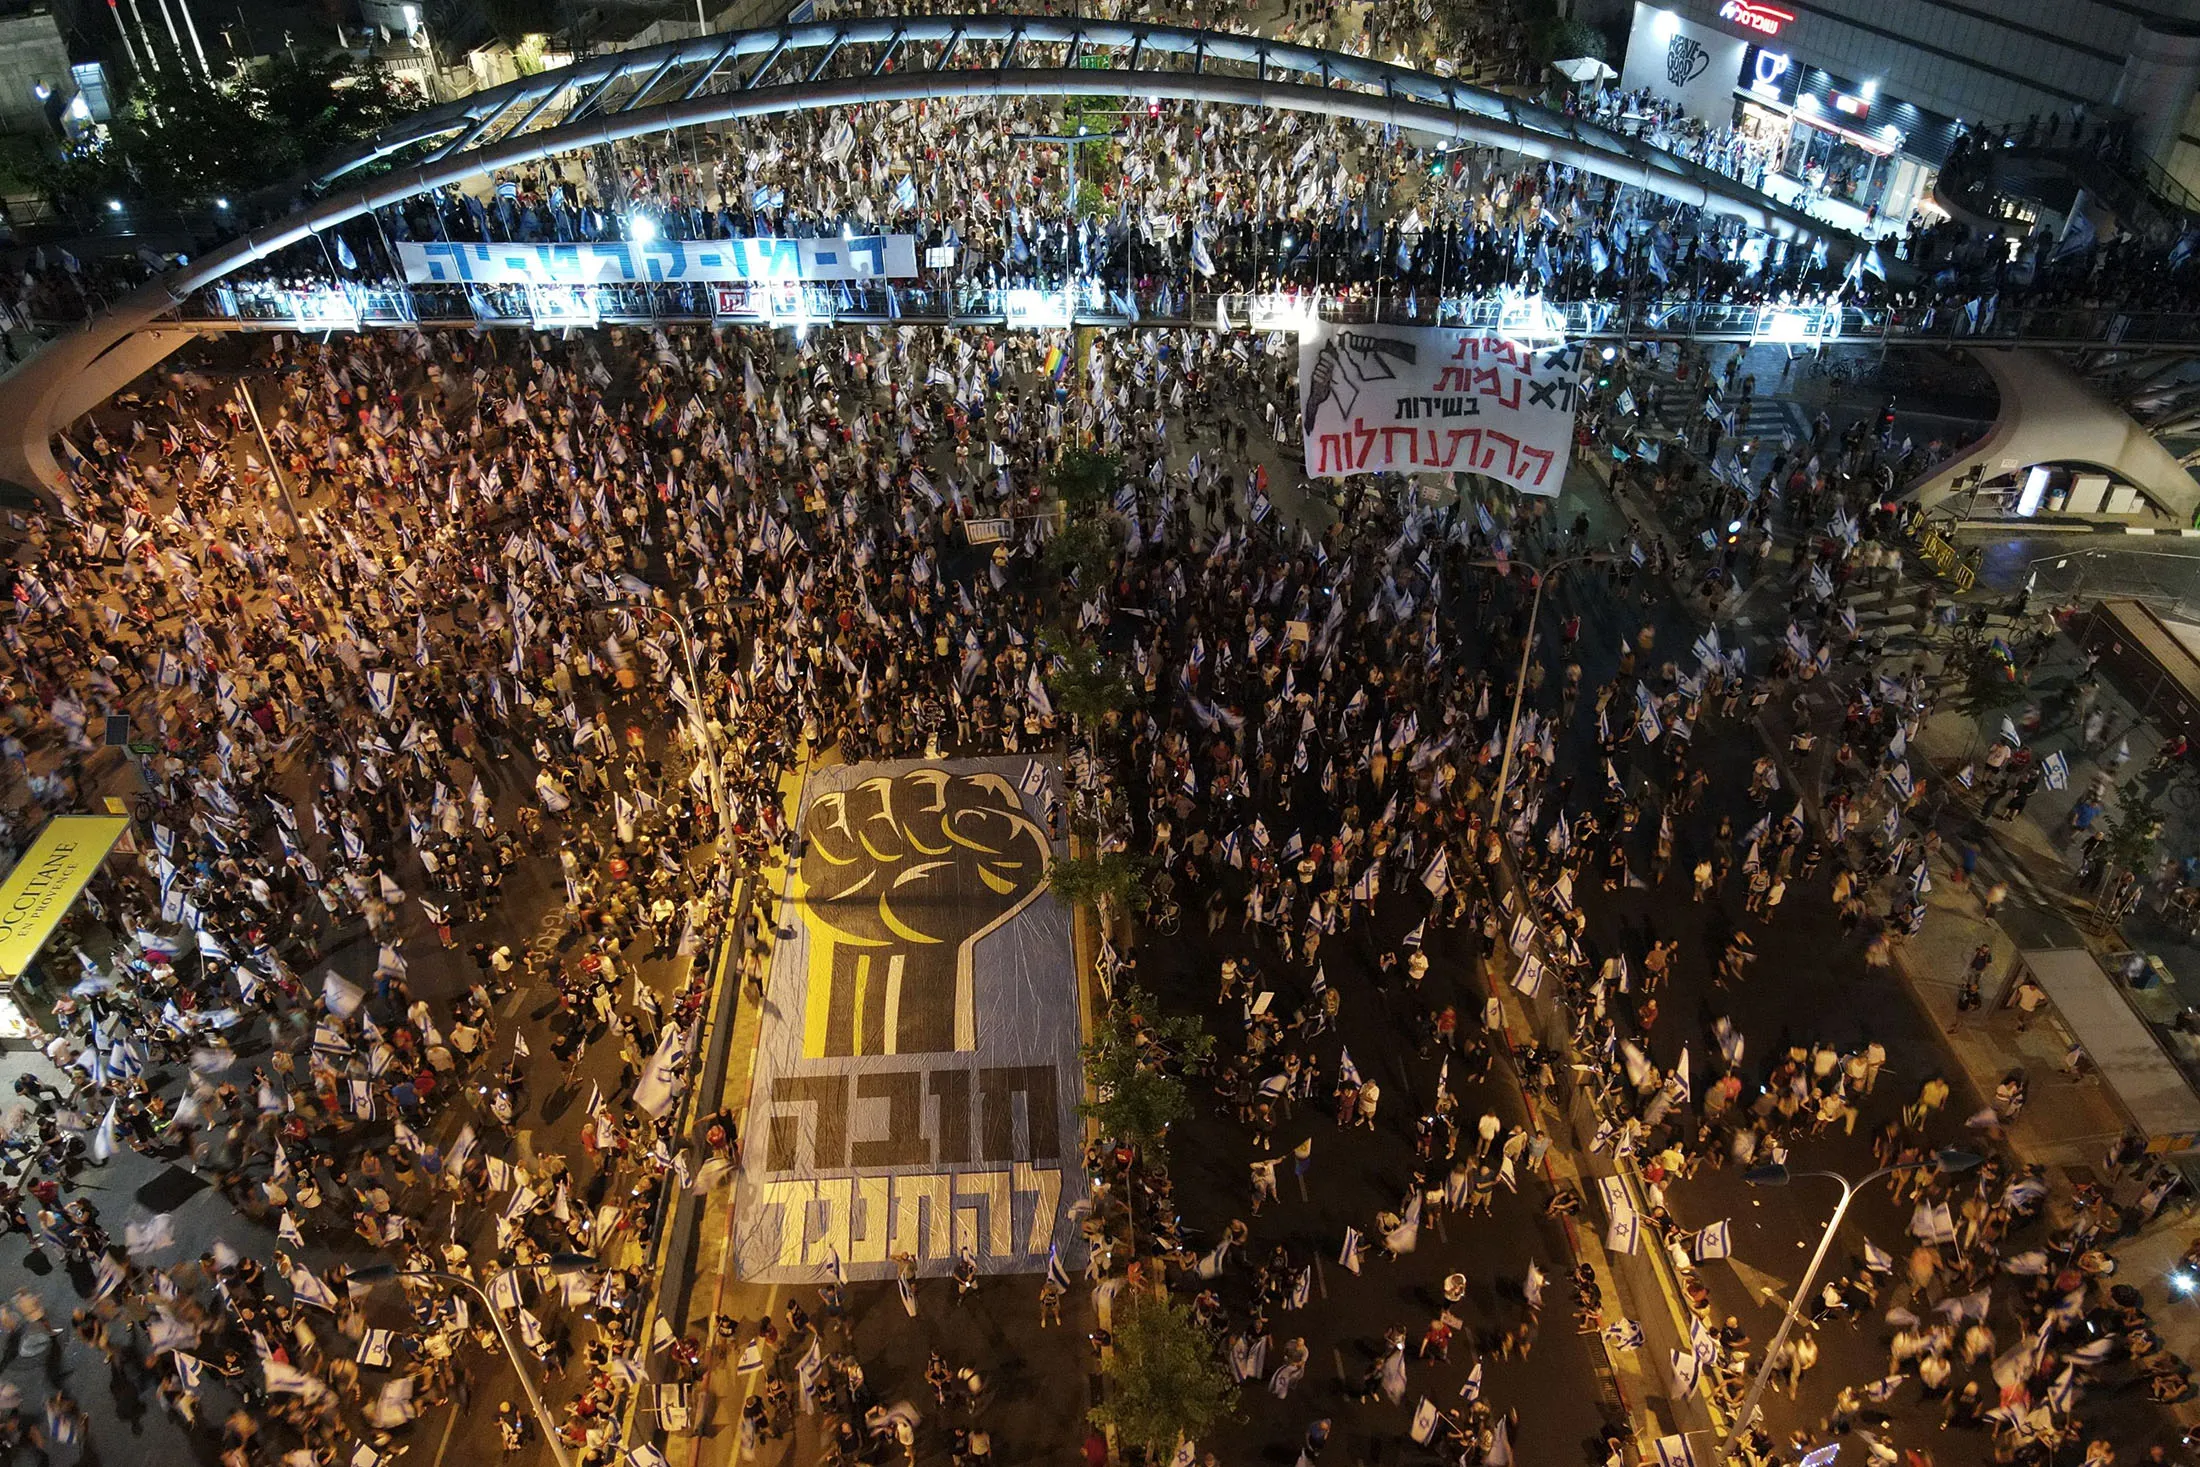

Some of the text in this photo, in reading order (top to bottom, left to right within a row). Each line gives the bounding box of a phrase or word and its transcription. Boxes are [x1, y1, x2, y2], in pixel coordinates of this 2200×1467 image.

[1667, 51, 1694, 76] GOOD
[1667, 70, 1688, 88] DAY
[1451, 337, 1583, 376] לא נמית
[1394, 396, 1480, 420] בשירות
[1433, 366, 1577, 412] ולא נמות
[1318, 417, 1555, 486] ההתנחלות
[18, 862, 79, 937] EN PROVENCE
[766, 1065, 1061, 1172] חובה
[763, 1161, 1063, 1266] להתנגד
